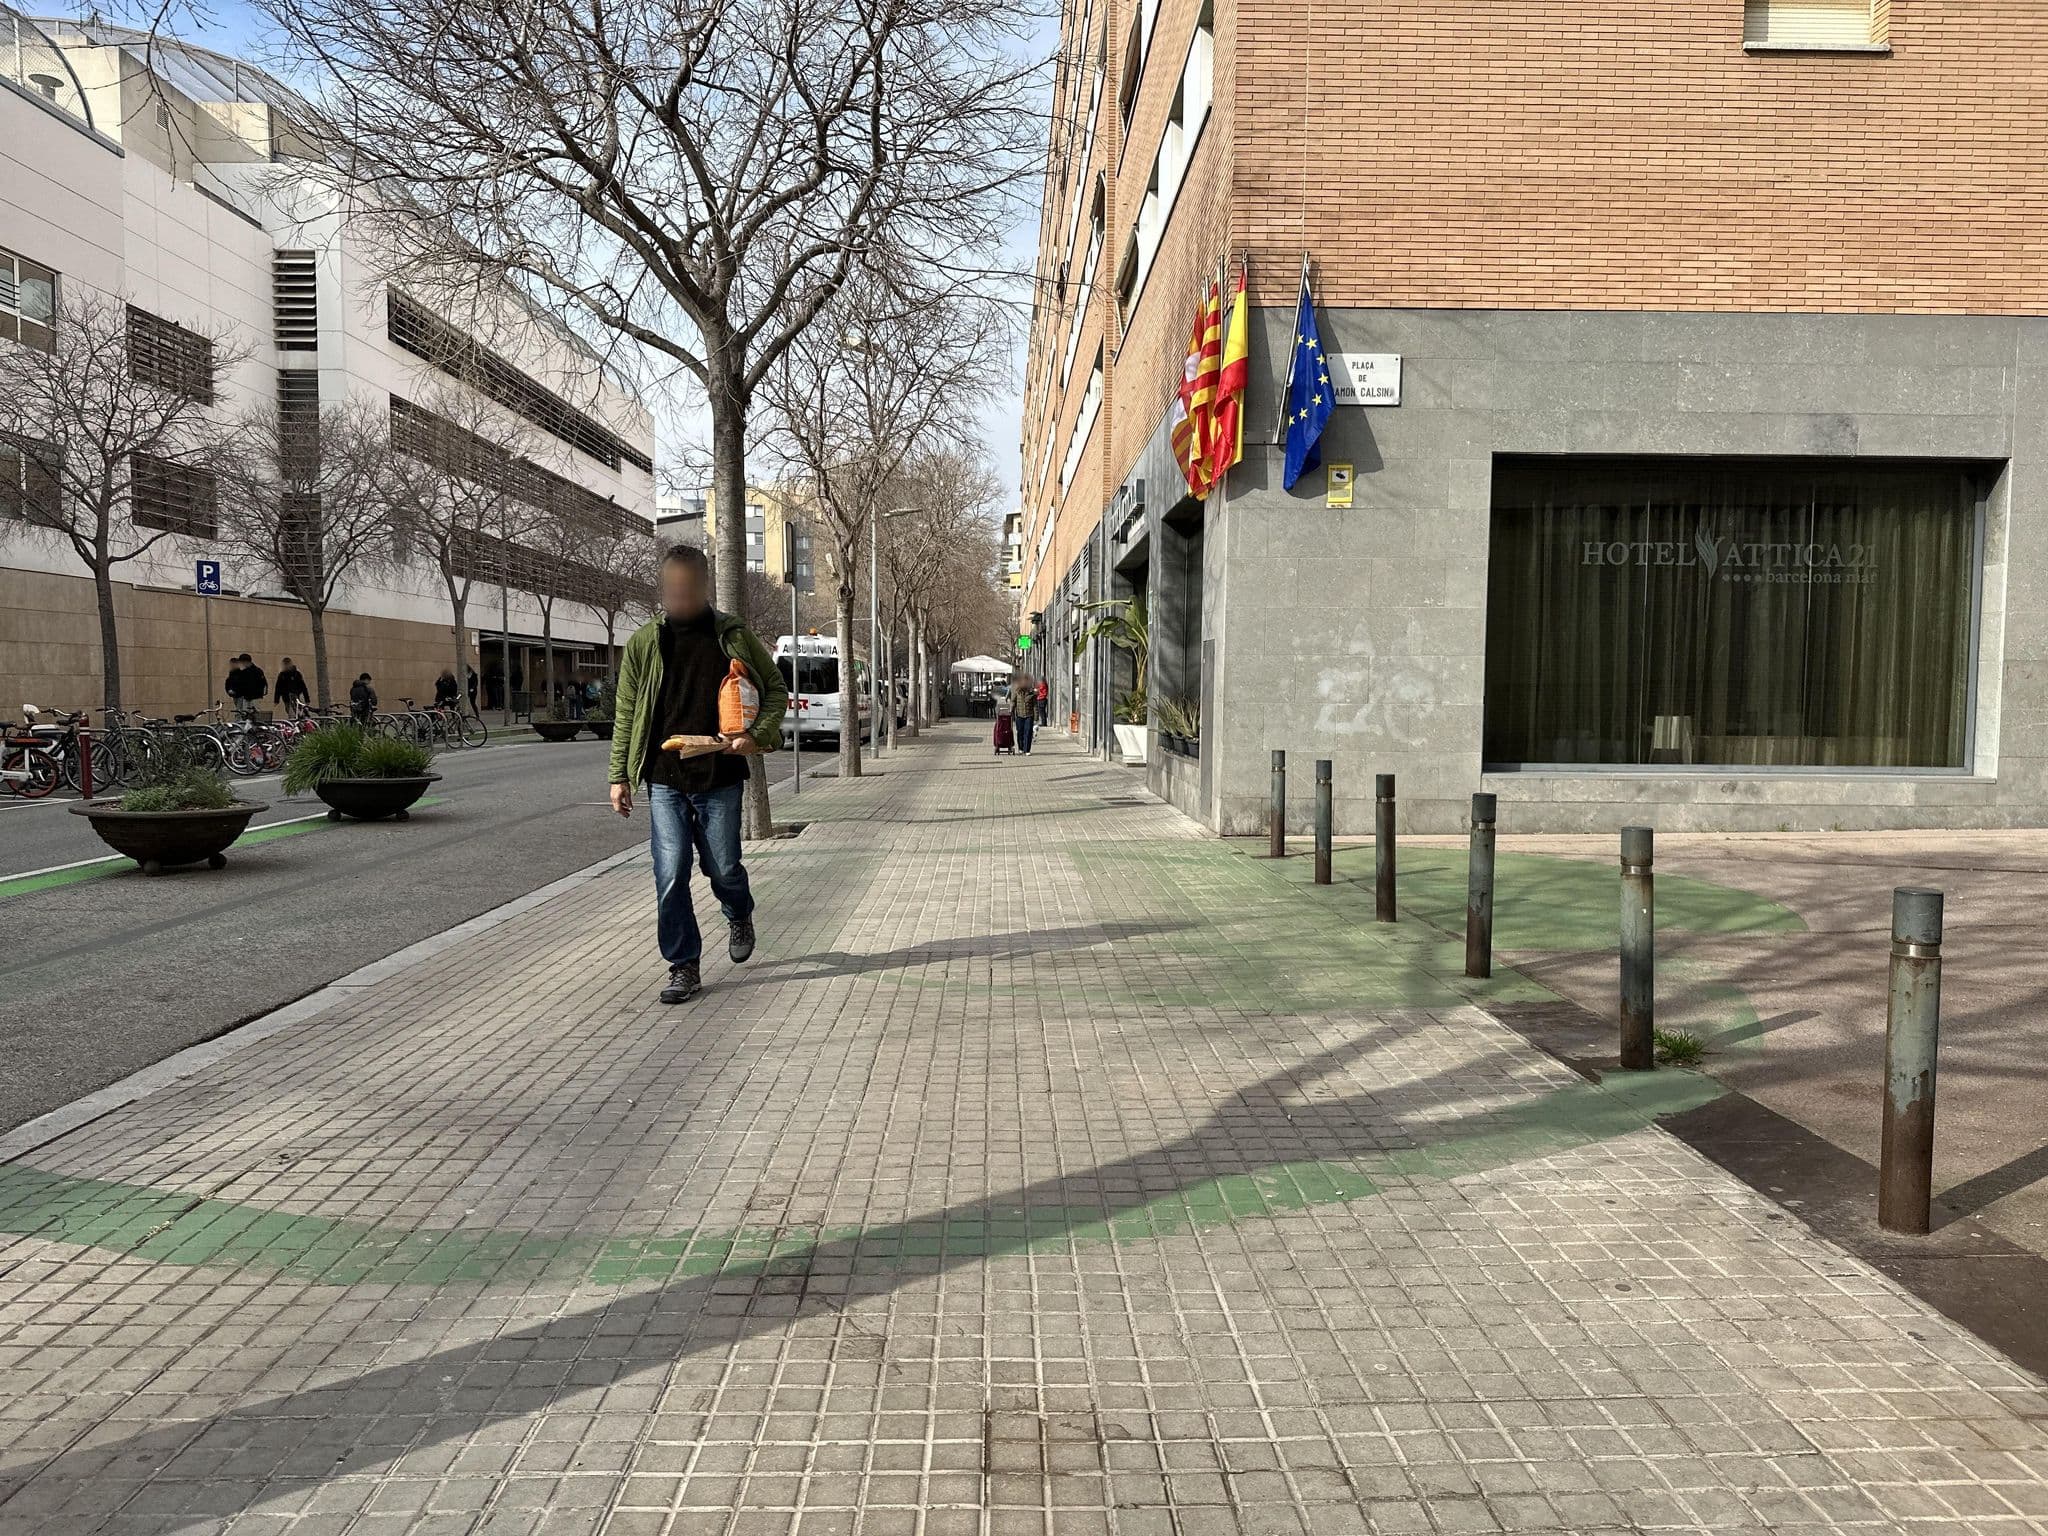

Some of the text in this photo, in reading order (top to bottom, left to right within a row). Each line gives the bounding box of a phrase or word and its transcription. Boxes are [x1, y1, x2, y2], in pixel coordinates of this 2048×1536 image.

[1352, 362, 1375, 370] PLAÇA
[1358, 374, 1367, 382] DE
[1335, 387, 1356, 397] AMON
[1581, 541, 1878, 568] HOTEL ATTICA21
[203, 565, 214, 578] P
